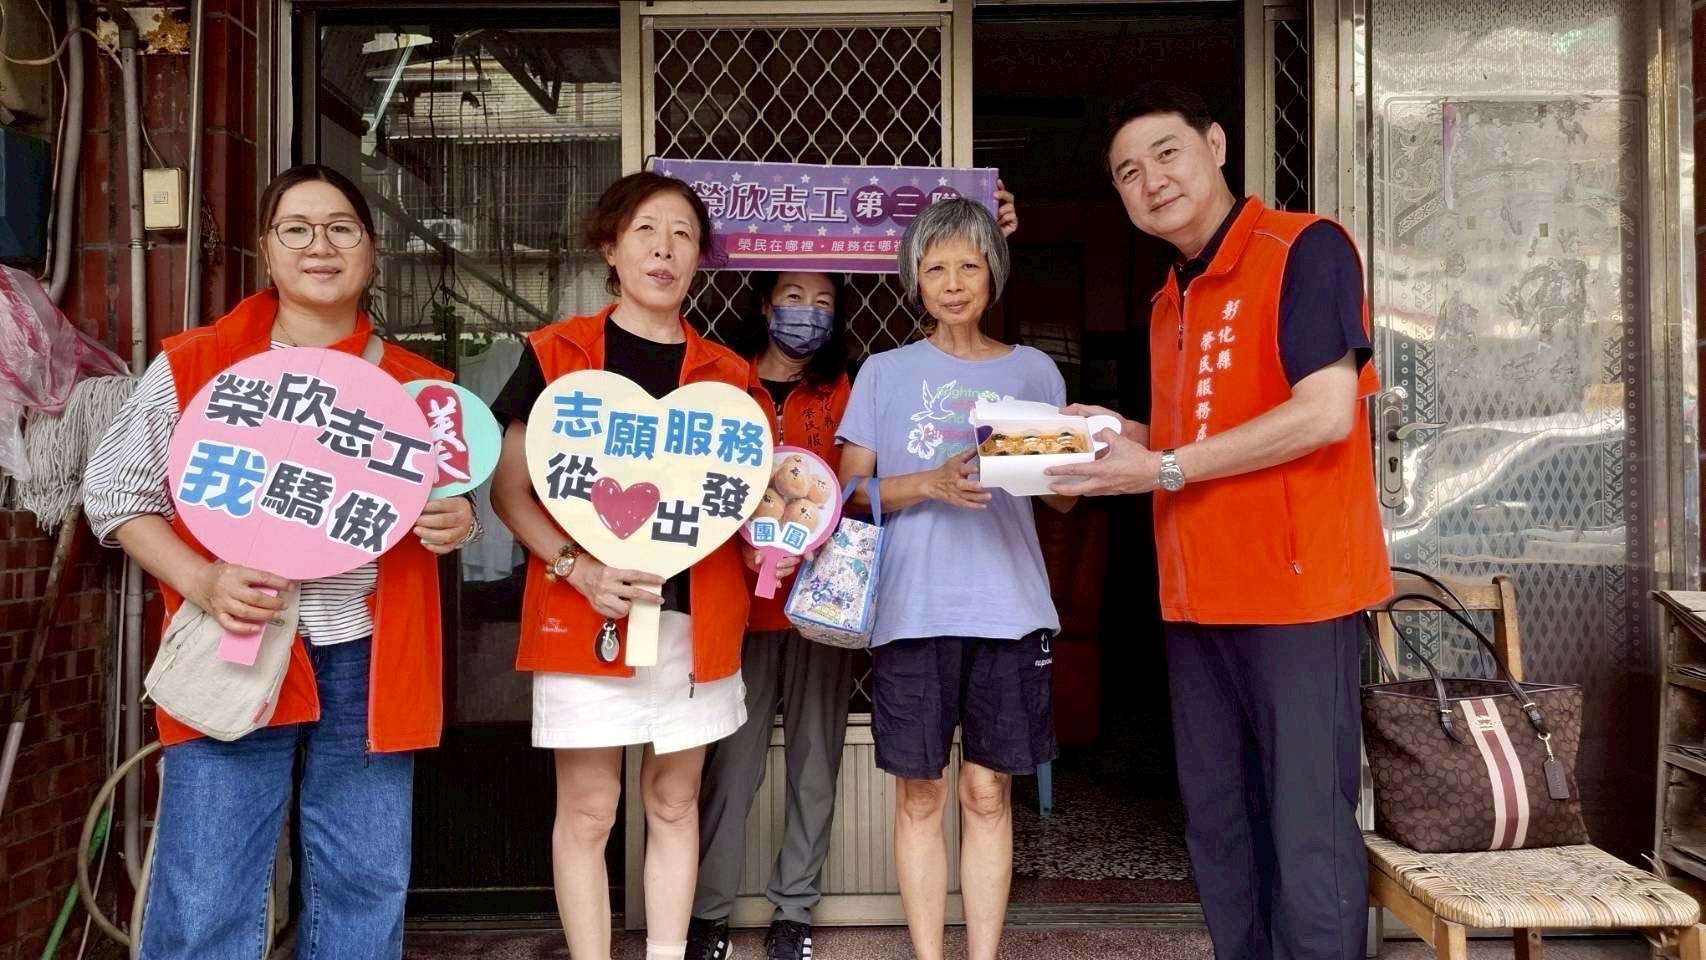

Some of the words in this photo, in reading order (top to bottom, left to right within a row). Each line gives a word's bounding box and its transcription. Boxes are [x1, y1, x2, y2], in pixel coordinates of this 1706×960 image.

[1216, 299, 1240, 369] 彰化縣
[205, 373, 432, 483] 榮欣志工
[553, 391, 765, 467] 志願服務
[179, 442, 398, 552] 我驕傲
[546, 453, 599, 502] 從
[651, 472, 750, 547] 出發
[754, 522, 808, 550] 團圓
